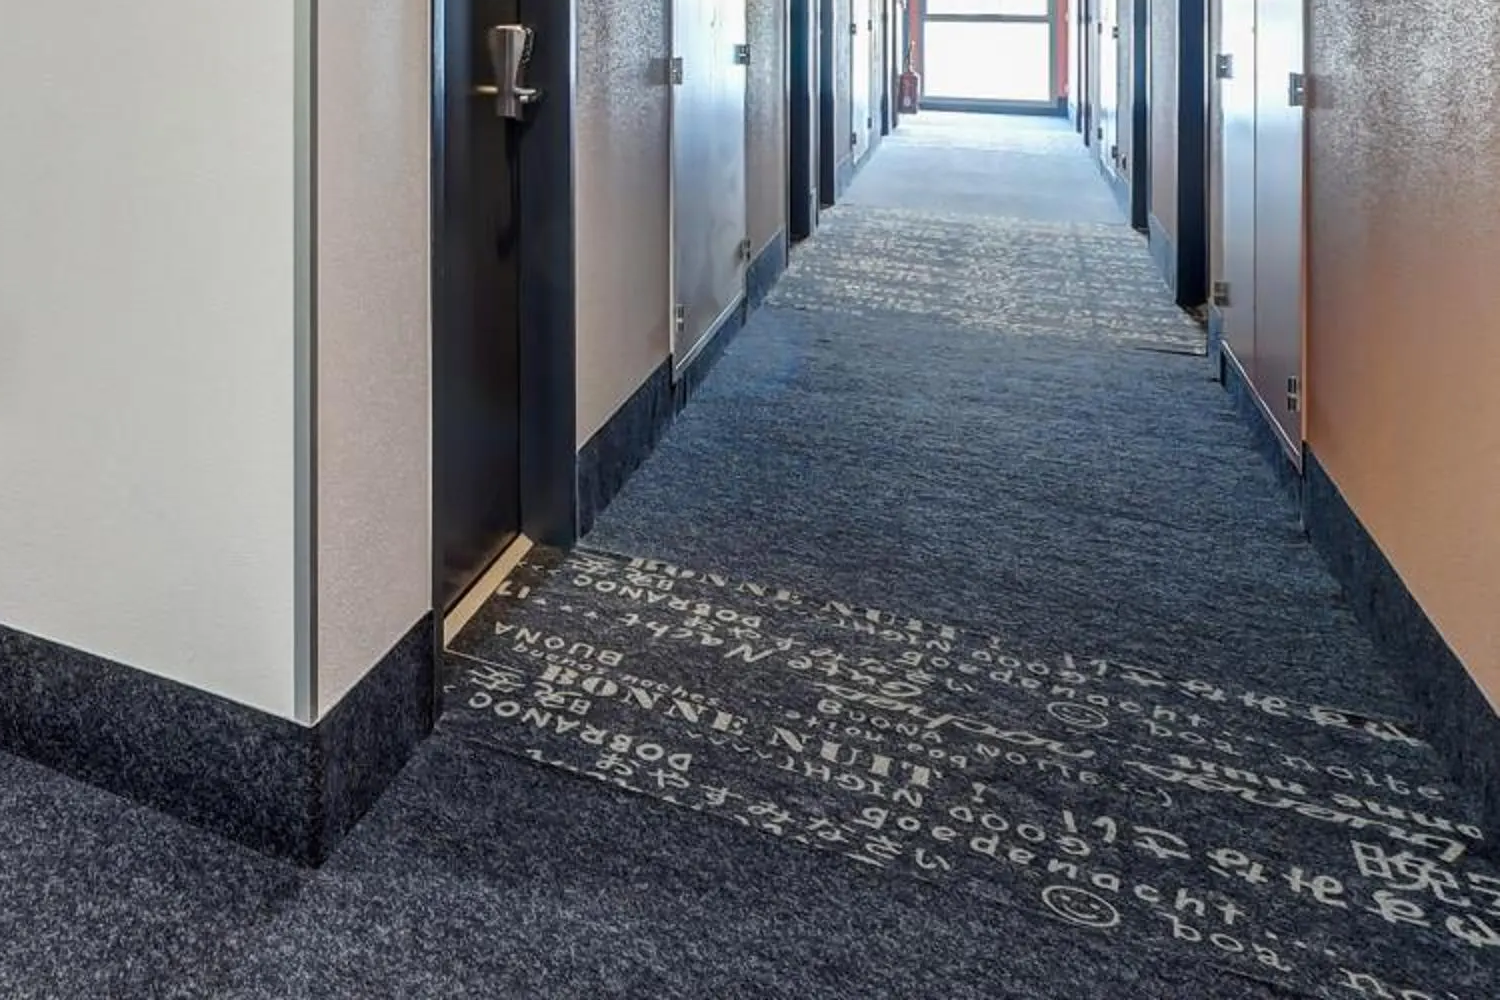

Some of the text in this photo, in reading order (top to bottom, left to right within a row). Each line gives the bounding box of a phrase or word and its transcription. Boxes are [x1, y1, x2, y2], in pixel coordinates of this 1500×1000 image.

[496, 622, 623, 666] BUONA
[469, 692, 692, 771] DOBRANOC
[541, 664, 747, 735] BONNE
[769, 727, 941, 788] NUIT
[949, 806, 1090, 855] GOOD
[1159, 912, 1291, 971] boa
